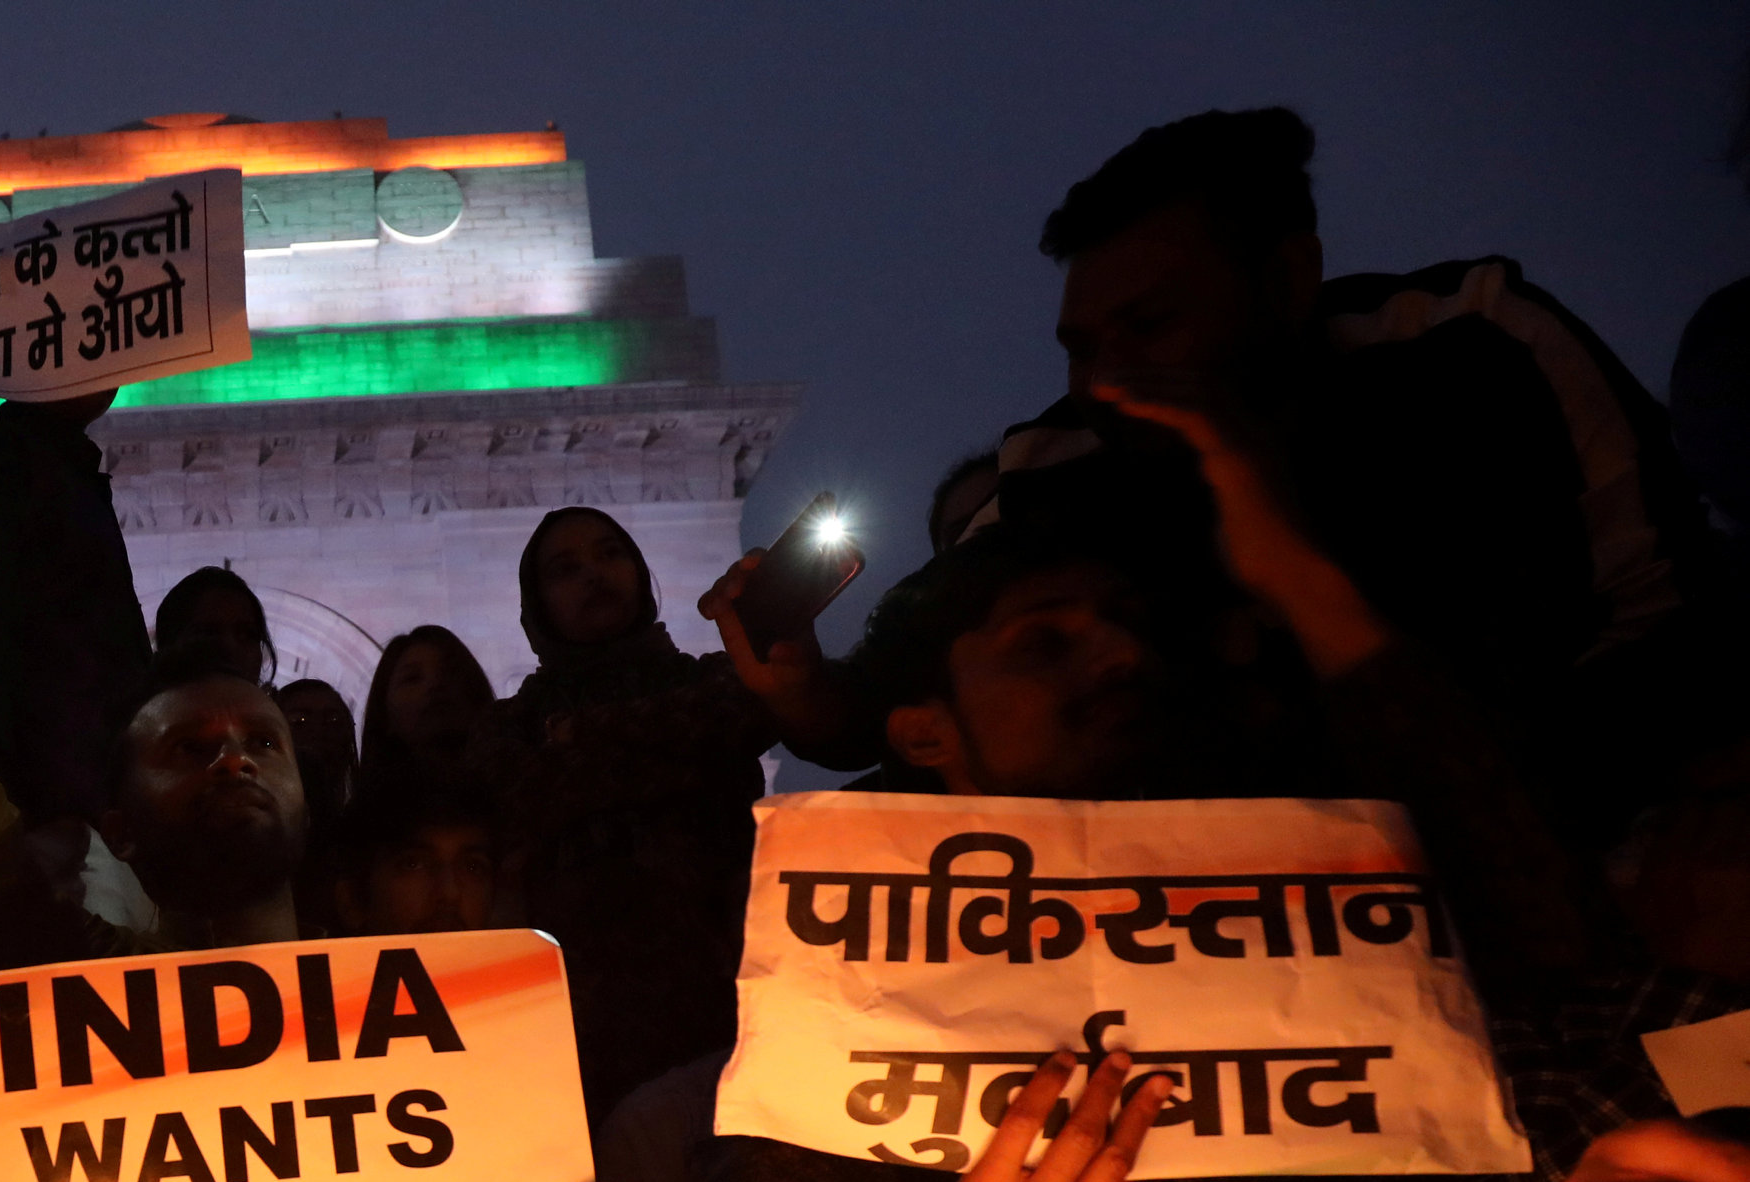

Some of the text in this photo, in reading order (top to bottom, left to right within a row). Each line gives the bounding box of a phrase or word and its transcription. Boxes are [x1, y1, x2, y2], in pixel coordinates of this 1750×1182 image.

[13, 219, 62, 286] के
[26, 292, 66, 373] मे
[779, 831, 1456, 964] पाकिस्तान
